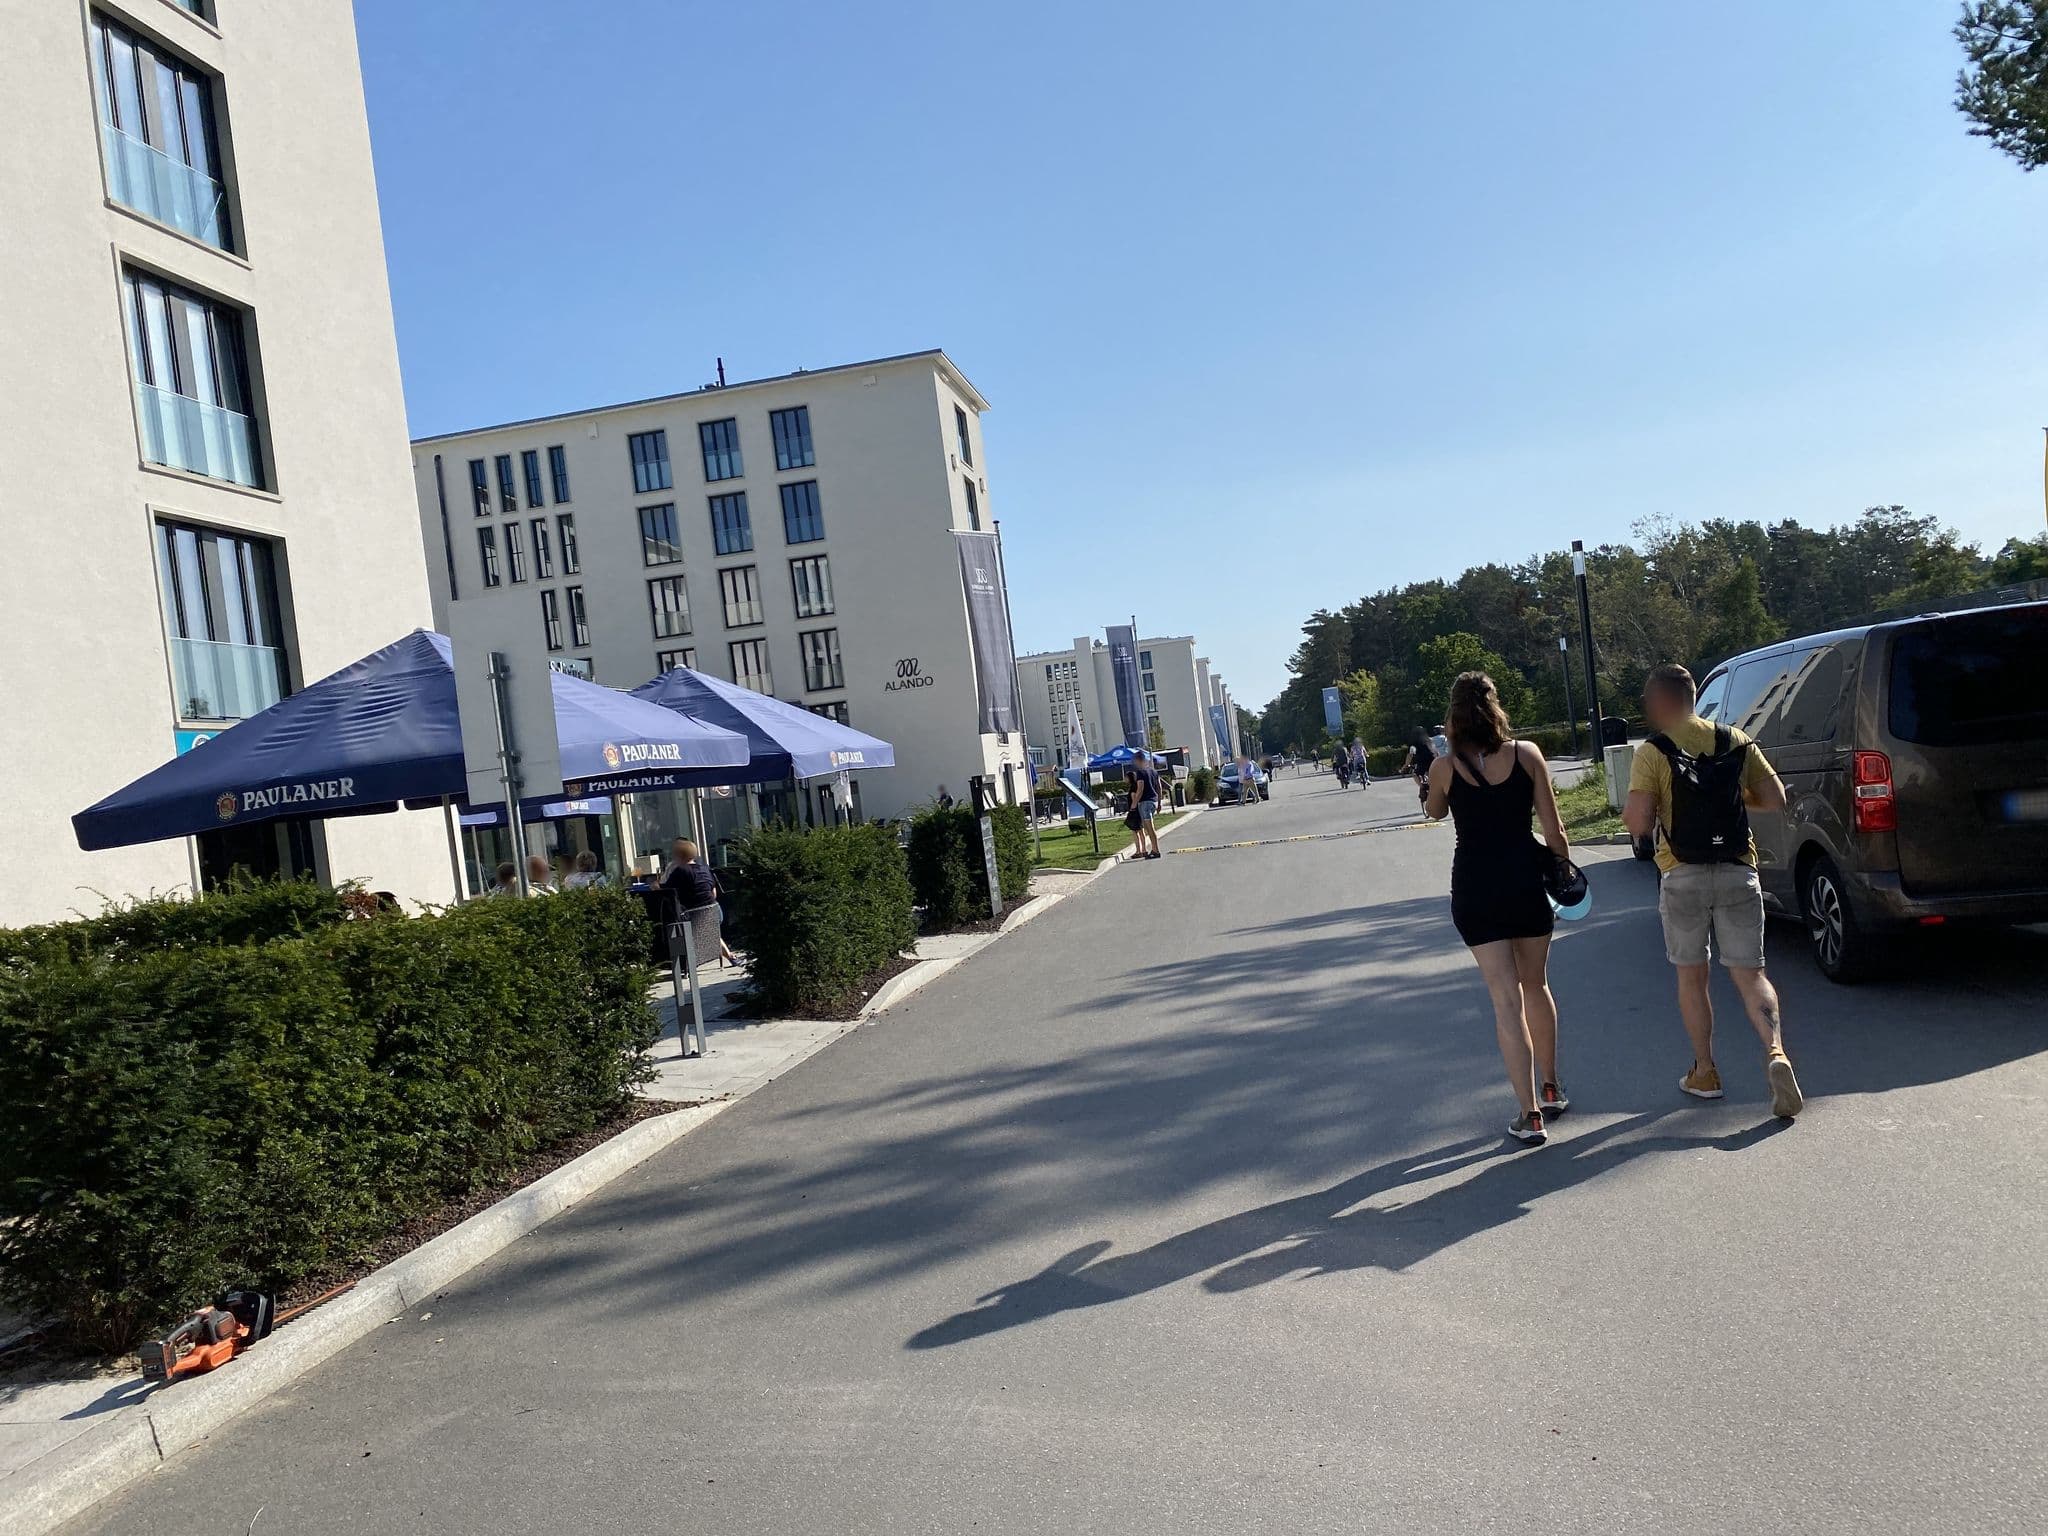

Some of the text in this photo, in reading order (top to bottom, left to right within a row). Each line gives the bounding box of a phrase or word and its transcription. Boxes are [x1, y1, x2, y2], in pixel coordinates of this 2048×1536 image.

[885, 676, 934, 691] ALANDO
[621, 743, 681, 762] PAULANER
[243, 777, 356, 811] PAULANER
